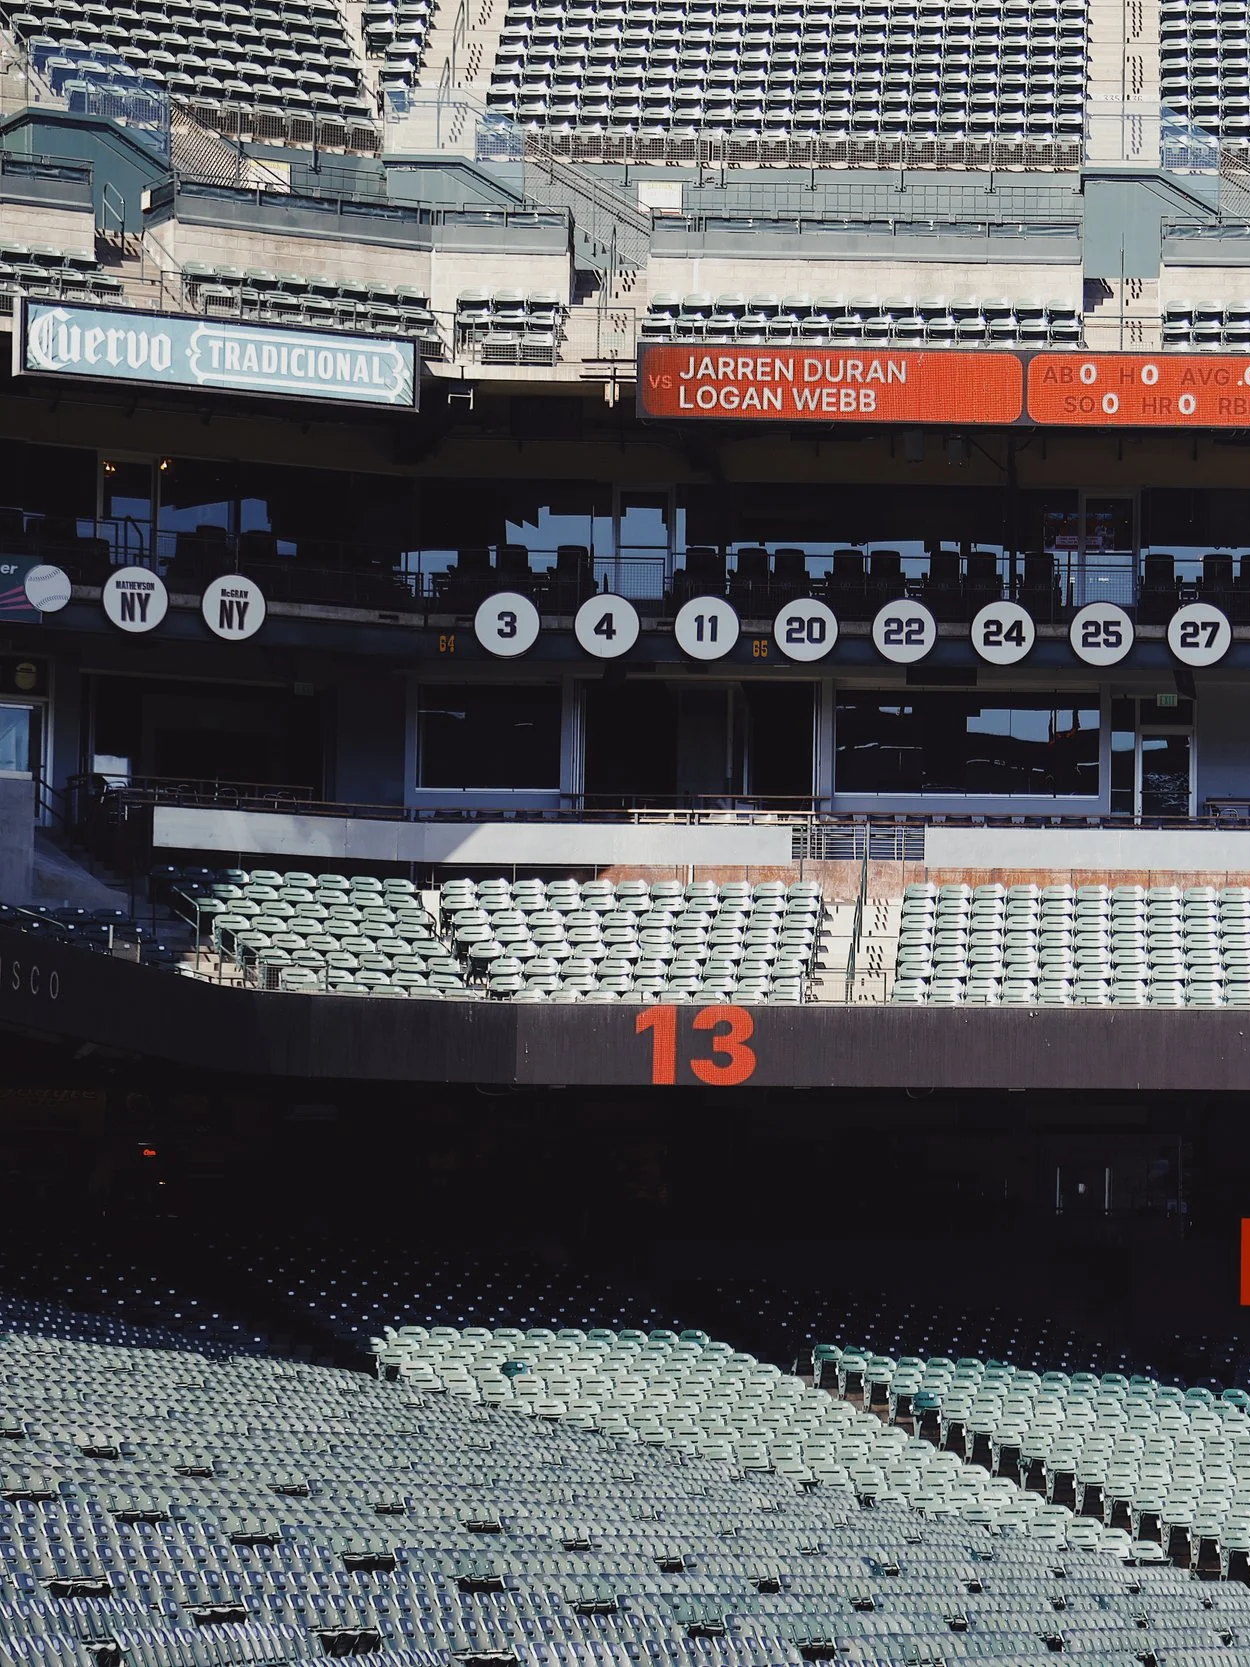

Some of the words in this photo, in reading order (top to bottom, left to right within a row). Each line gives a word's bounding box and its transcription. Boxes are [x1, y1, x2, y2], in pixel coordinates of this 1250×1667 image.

[29, 307, 172, 372] Cuervo
[207, 339, 386, 386] TRADICIONAL
[679, 356, 794, 383] JARREN
[804, 359, 907, 384] DURAN
[1042, 366, 1074, 384] AB
[1079, 363, 1098, 386] 0
[1119, 367, 1136, 385] H
[1141, 364, 1159, 386] 0
[1180, 367, 1230, 387] AVG
[679, 386, 783, 411] LOGAN
[794, 387, 877, 413] WEBB
[1063, 395, 1096, 414] SO
[1101, 393, 1119, 415] 0
[1142, 396, 1172, 415] HR
[1178, 394, 1197, 416] 0
[116, 580, 155, 591] MATHEWSON
[120, 592, 151, 623] NY
[219, 600, 249, 630] NY
[497, 611, 518, 638] 3
[594, 612, 617, 640] 4
[693, 615, 719, 642] 11
[785, 617, 827, 644] 20
[883, 618, 925, 645] 22
[982, 620, 1026, 647] 24
[1081, 621, 1123, 648] 25
[1180, 621, 1221, 648] 27
[635, 1005, 757, 1086] 13
